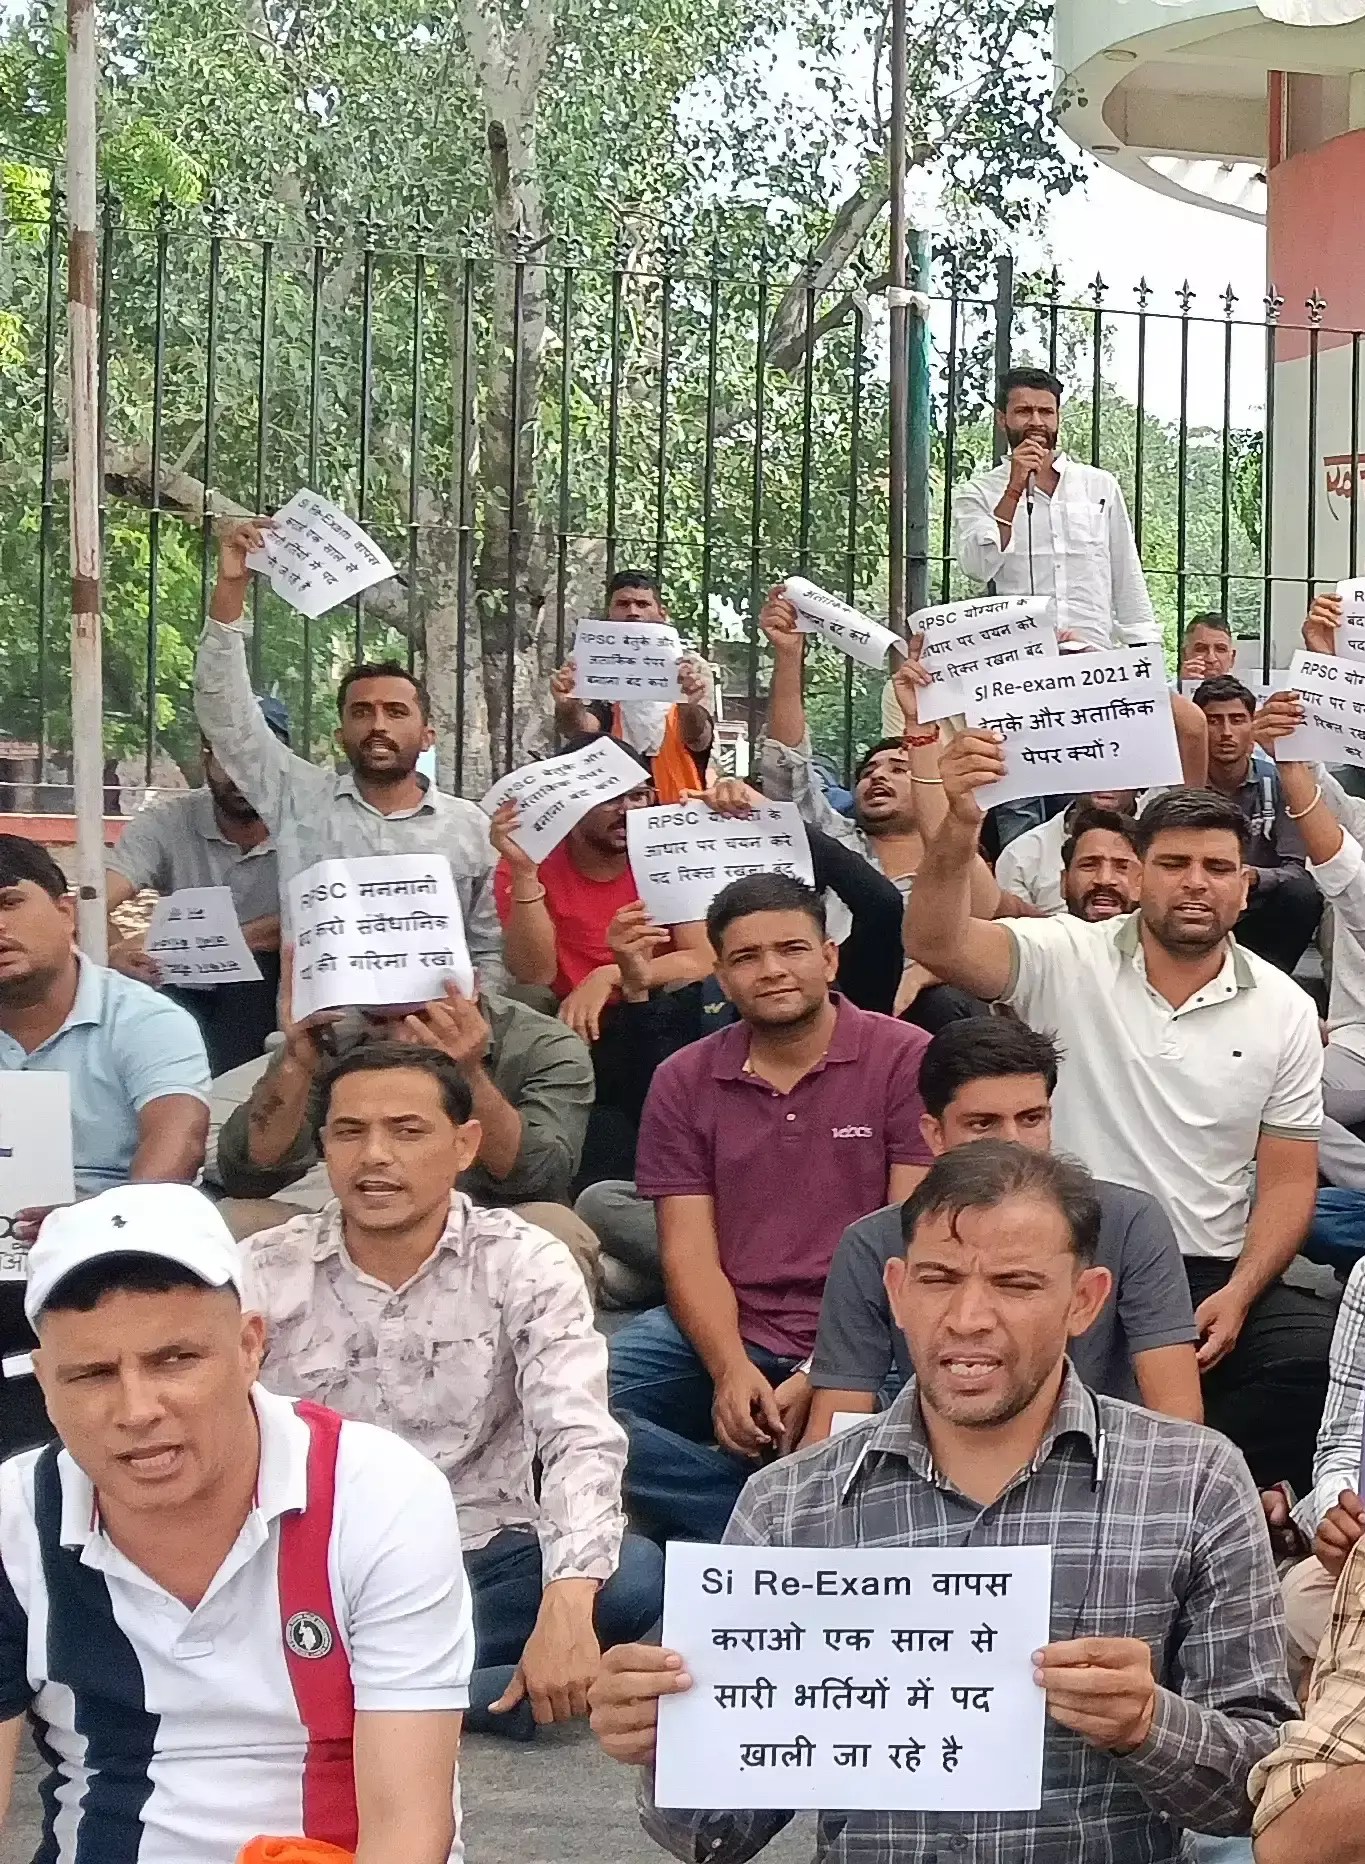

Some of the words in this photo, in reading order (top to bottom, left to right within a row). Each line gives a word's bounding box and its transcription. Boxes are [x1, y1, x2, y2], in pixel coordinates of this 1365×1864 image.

[958, 634, 976, 650] पर
[980, 625, 1013, 644] चयन
[1016, 615, 1039, 634] करे
[974, 685, 988, 703] SI
[992, 675, 1077, 697] Re-exam
[1082, 666, 1126, 686] 2021
[1301, 661, 1338, 681] RPSC
[1029, 705, 1067, 731] और
[1071, 696, 1155, 727] अतार्किक
[1021, 741, 1063, 766] पेपर
[1111, 740, 1121, 758] ?
[648, 812, 699, 830] RPSC
[702, 1568, 734, 1596] Si
[754, 1569, 912, 1598] Re-Exam
[932, 1572, 1013, 1598] वापस
[711, 1622, 806, 1654] कराओ
[823, 1626, 874, 1652] एक
[891, 1628, 952, 1654] साल
[970, 1622, 998, 1653] से
[714, 1678, 777, 1711] सारी
[794, 1675, 890, 1711] भर्तियों
[906, 1675, 934, 1712] में
[951, 1685, 994, 1714] पद
[833, 1742, 871, 1768] जा
[888, 1736, 925, 1774] रहे
[940, 1734, 963, 1774] है
